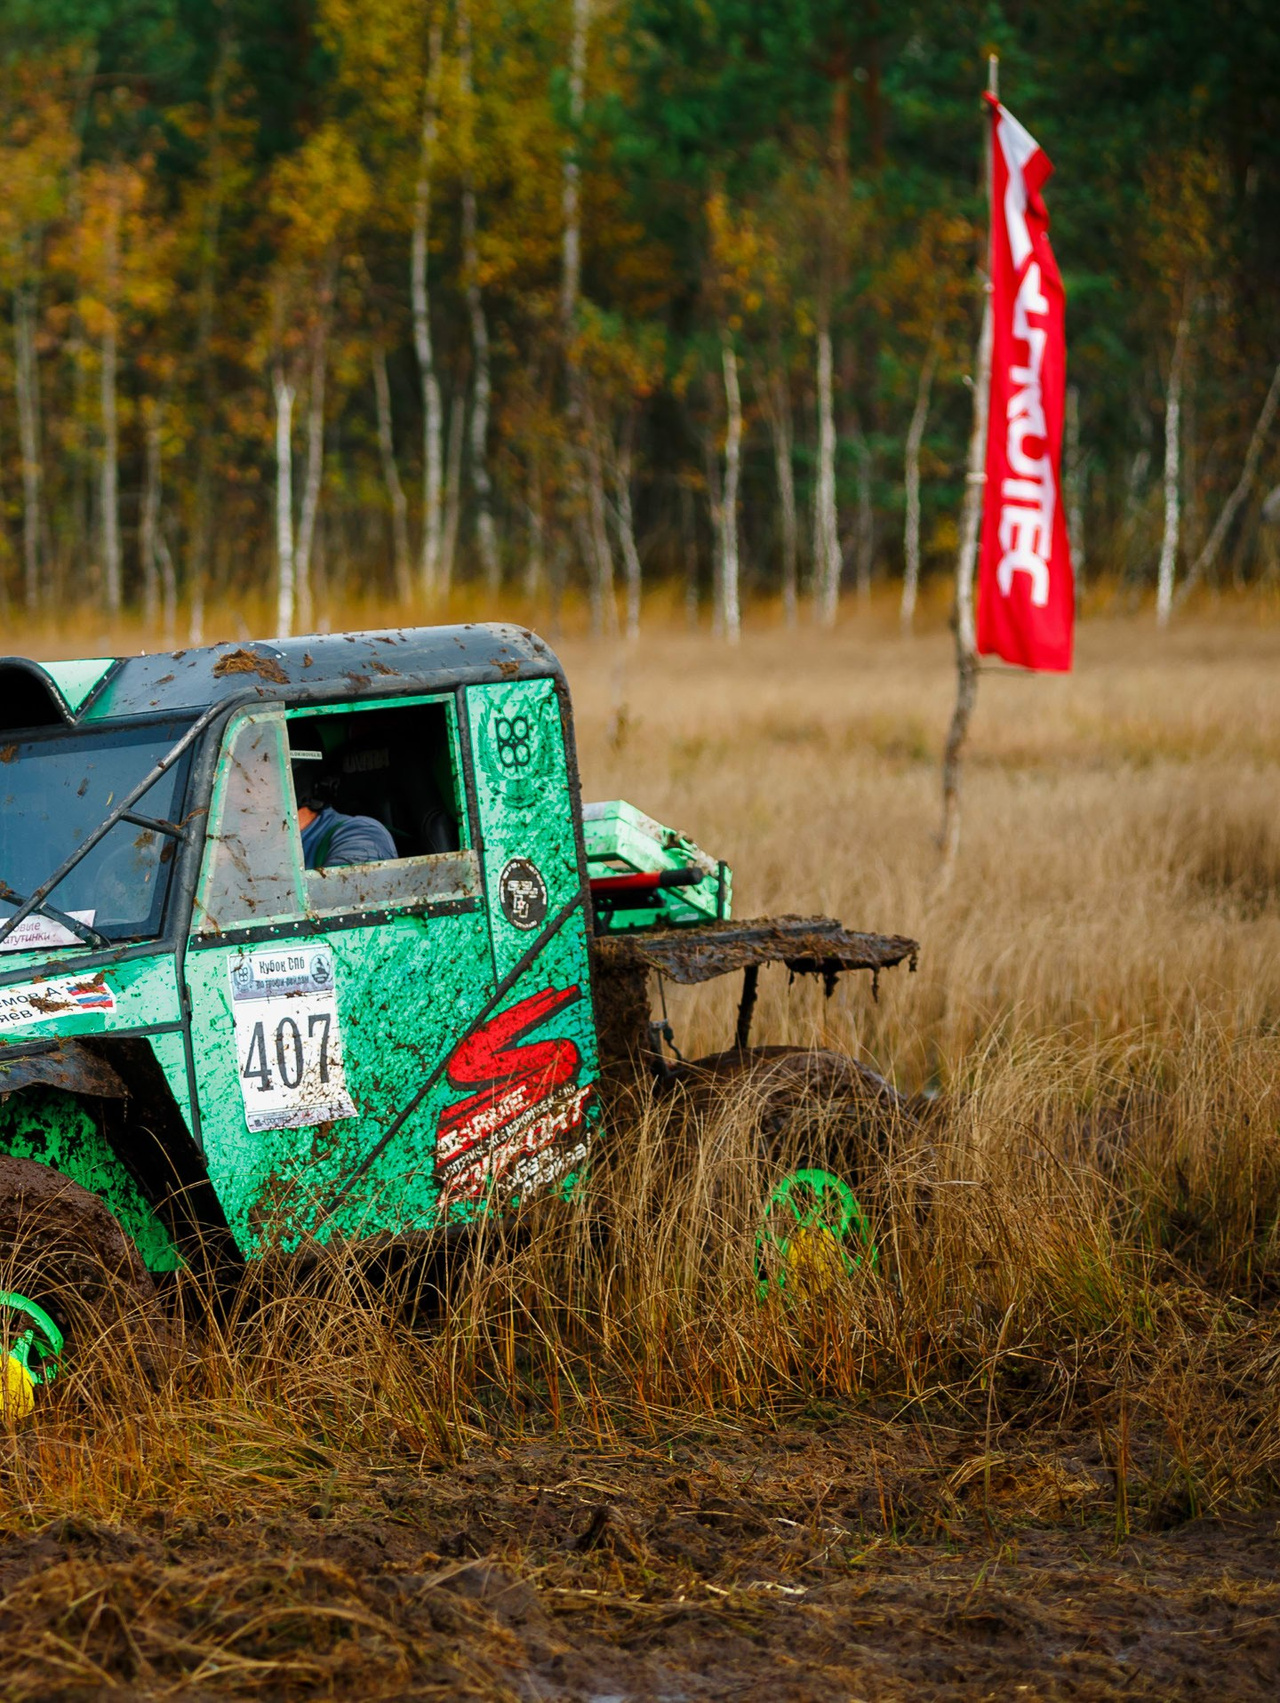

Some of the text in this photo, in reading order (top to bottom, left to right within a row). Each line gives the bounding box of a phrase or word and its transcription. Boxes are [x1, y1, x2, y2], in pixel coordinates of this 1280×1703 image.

[13, 922, 41, 933] овые
[3, 933, 51, 946] атутинки
[243, 1013, 331, 1092] 407
